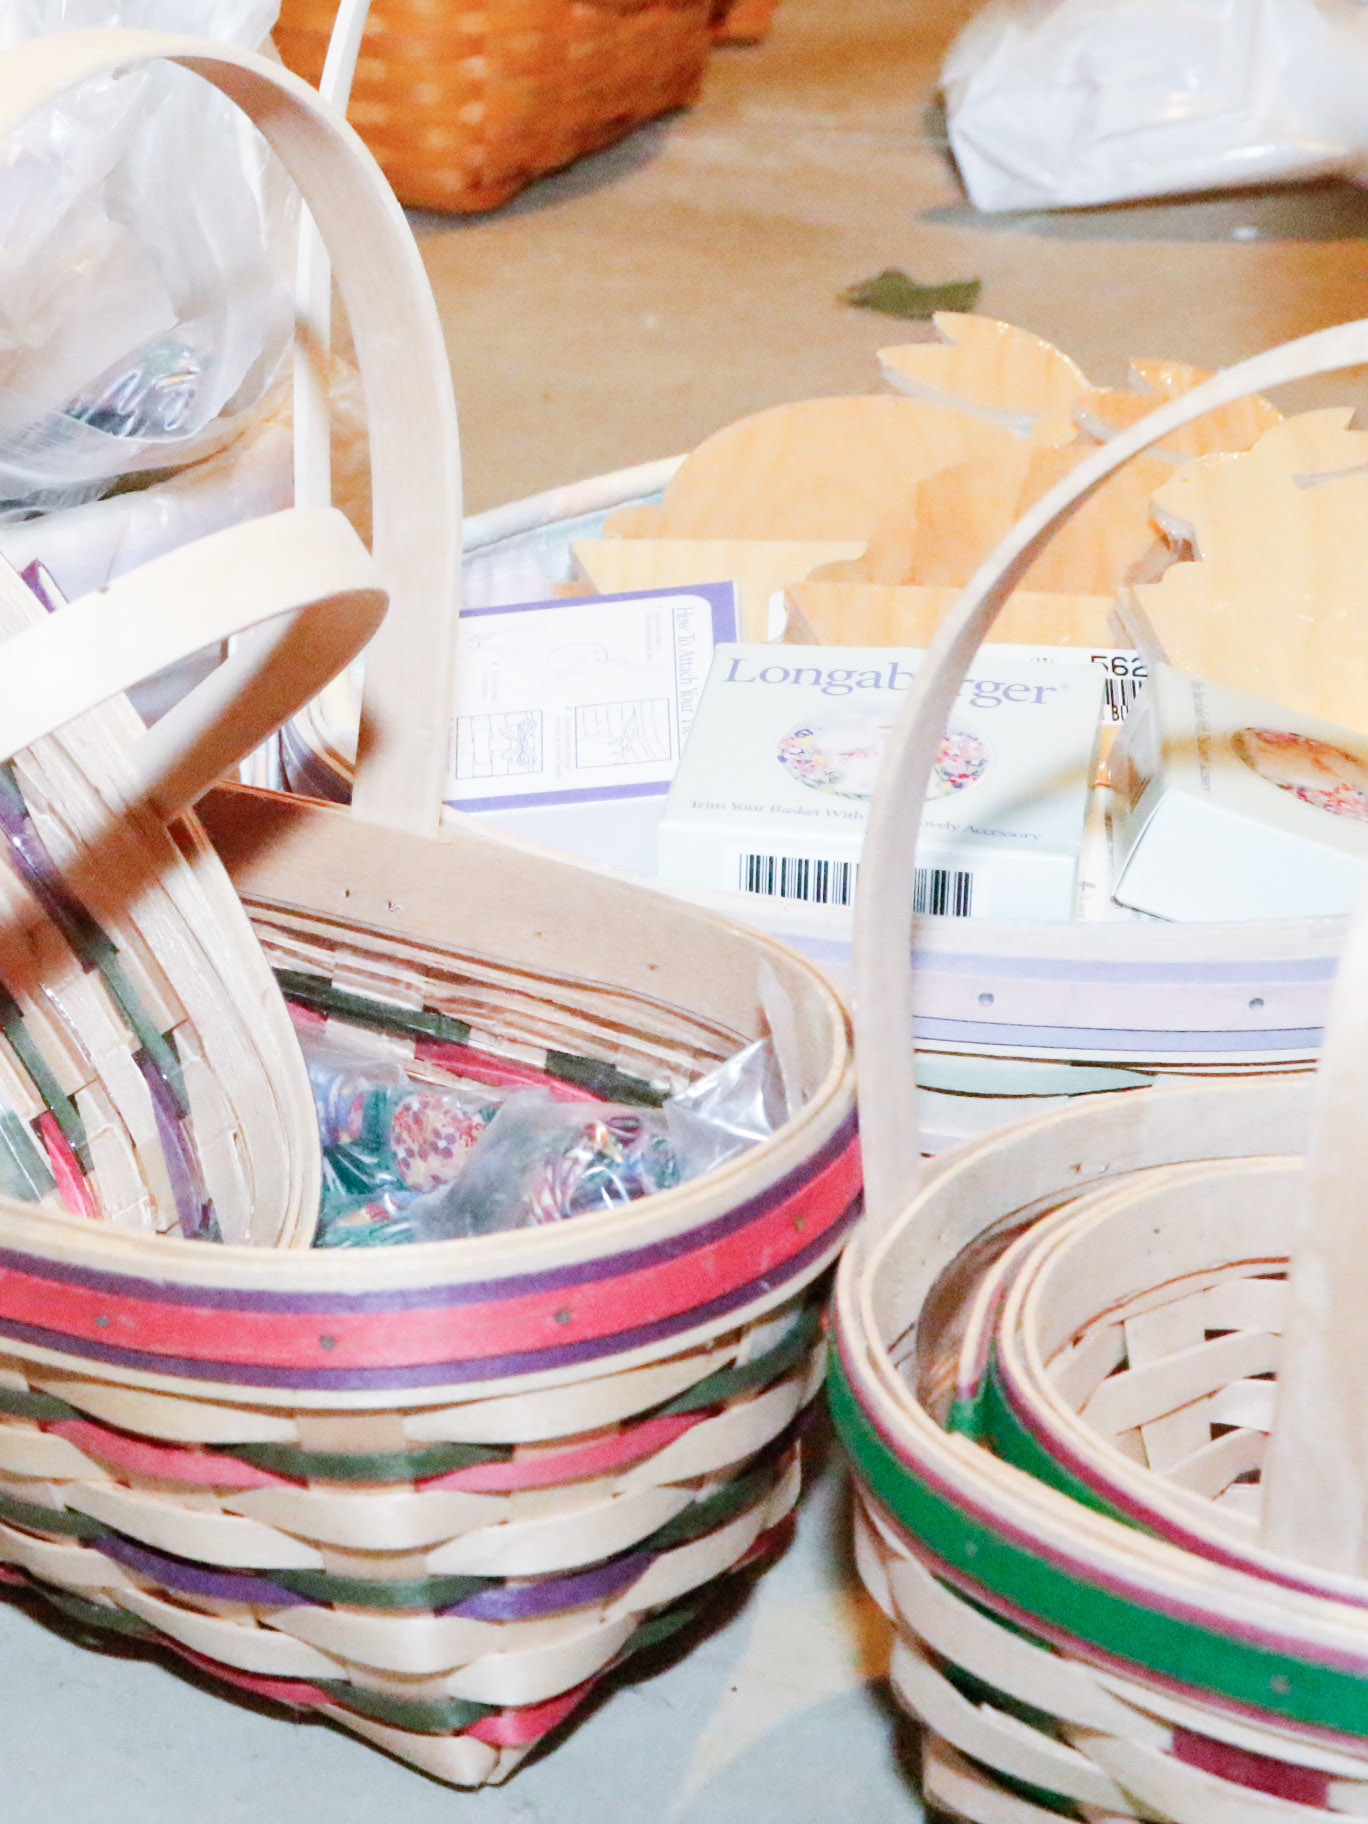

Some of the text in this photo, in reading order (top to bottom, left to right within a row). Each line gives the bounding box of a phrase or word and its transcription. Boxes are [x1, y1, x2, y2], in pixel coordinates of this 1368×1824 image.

[676, 607, 694, 630] How
[677, 632, 696, 647] To
[678, 649, 699, 685] Attach
[722, 657, 1058, 709] Longabger
[680, 687, 699, 713] Your
[689, 799, 727, 811] Trim
[730, 801, 766, 813] Your
[770, 804, 821, 817] Basket
[825, 808, 865, 821] With
